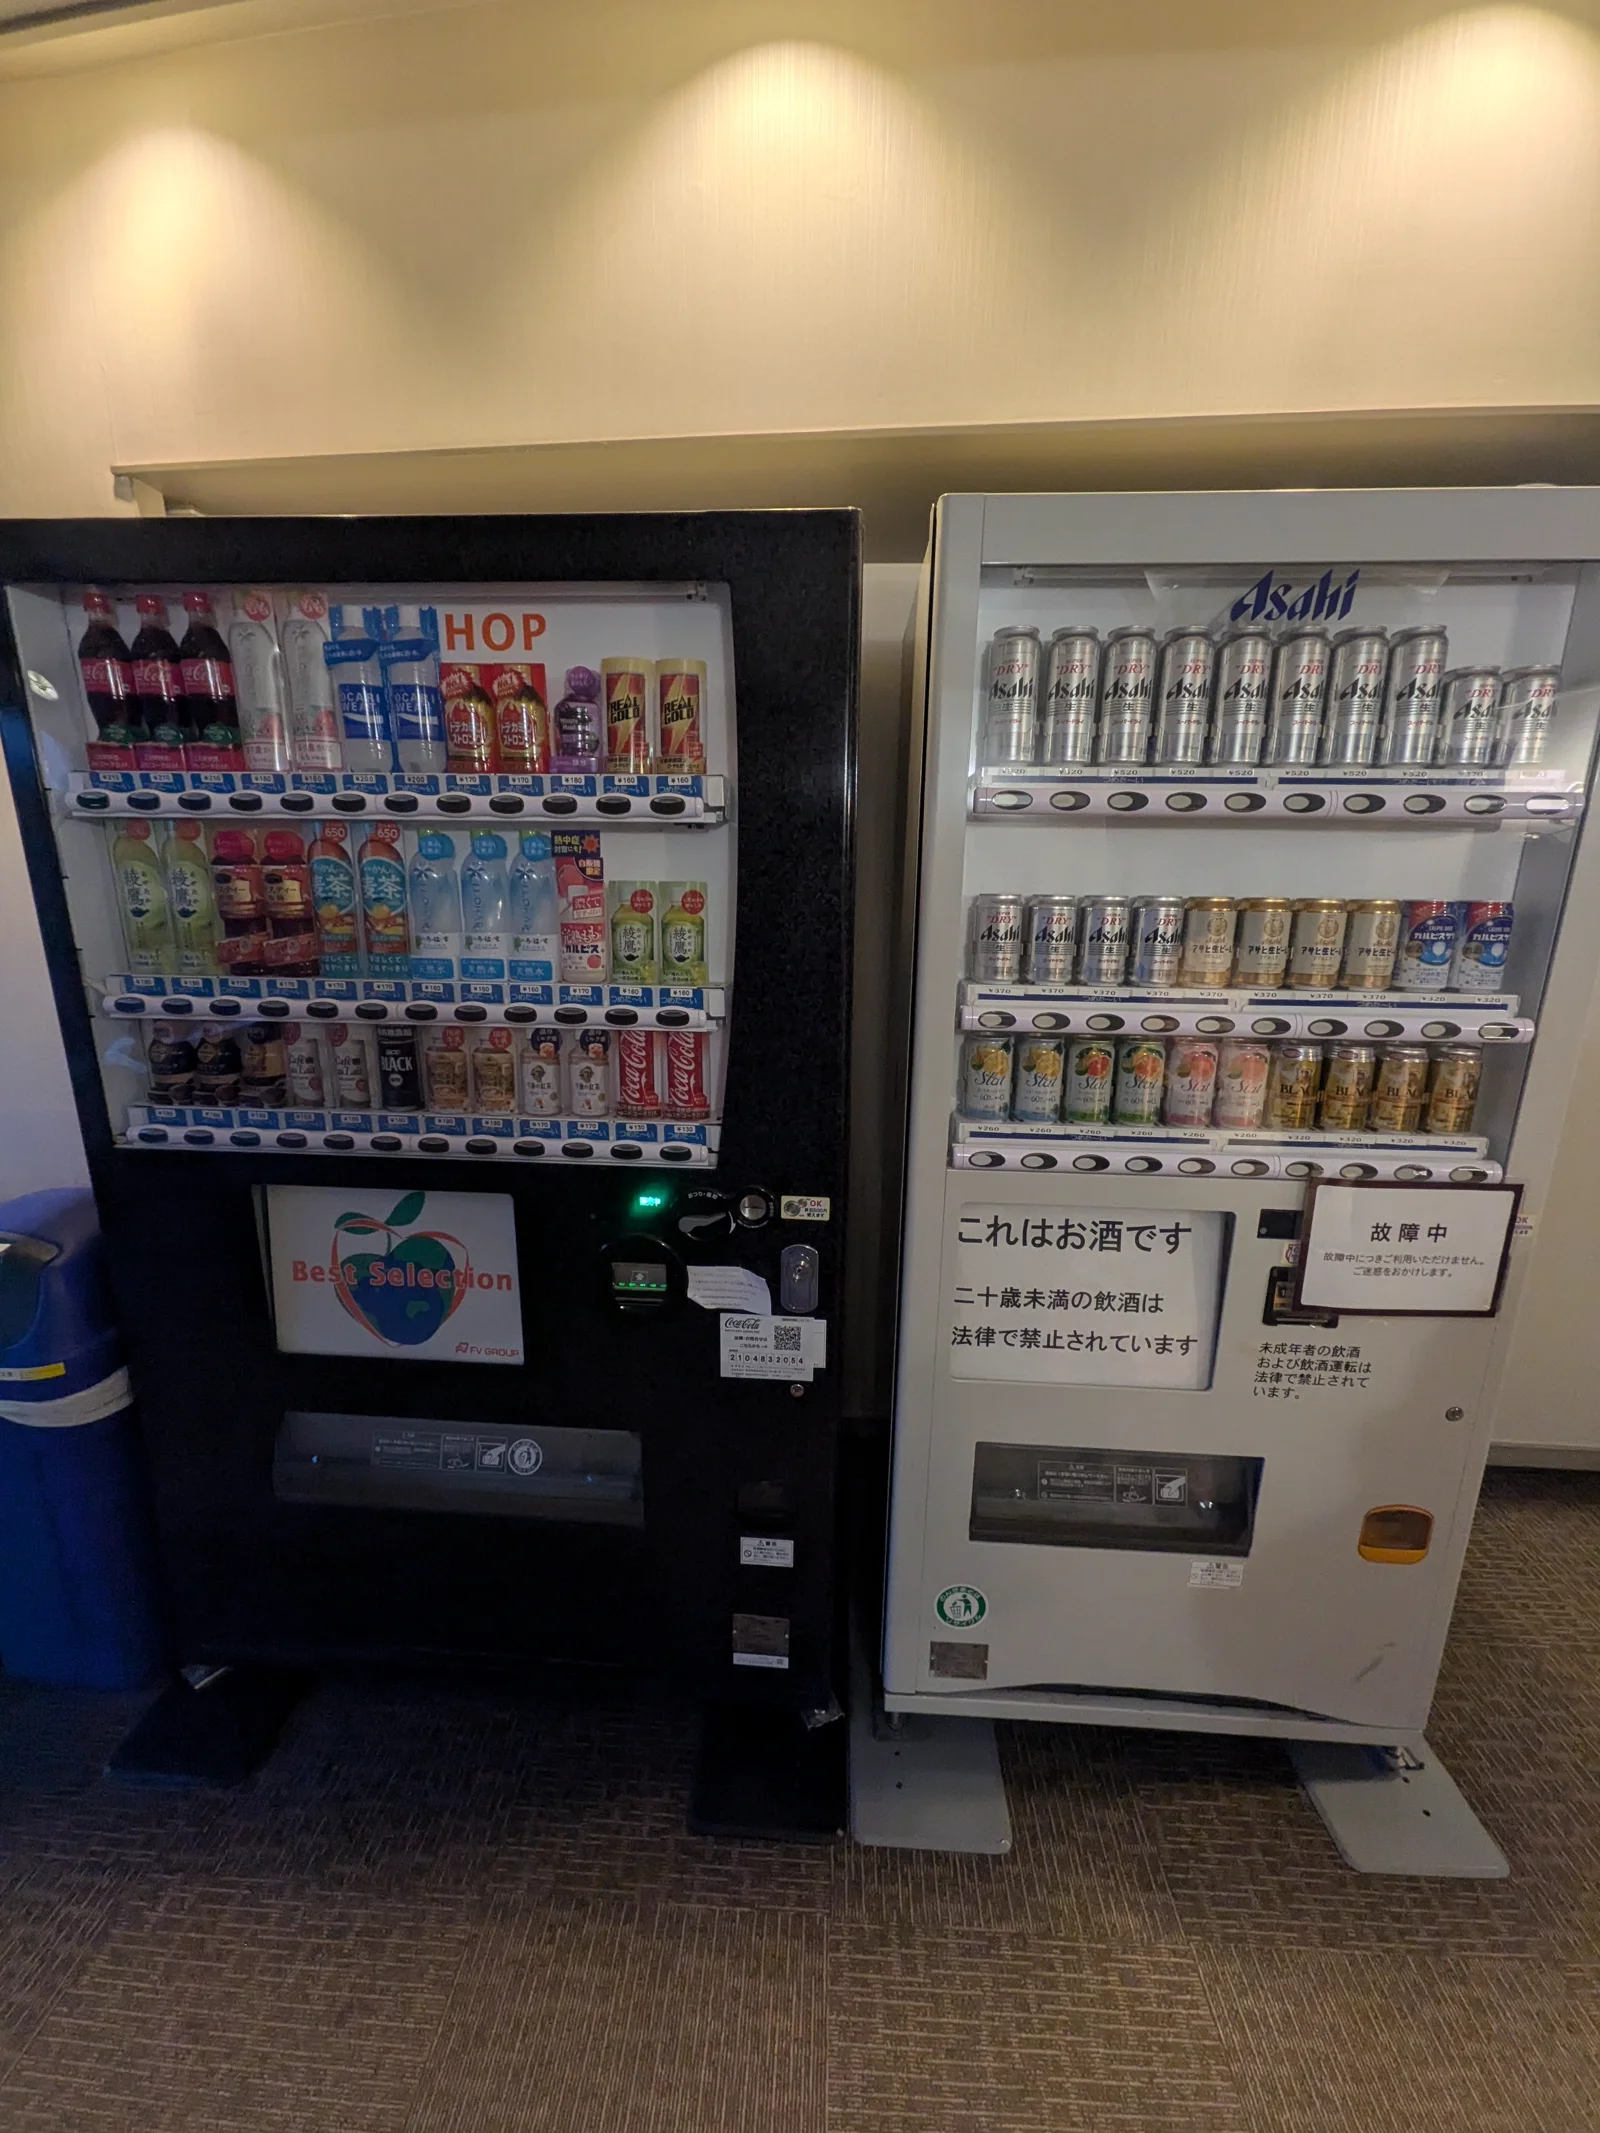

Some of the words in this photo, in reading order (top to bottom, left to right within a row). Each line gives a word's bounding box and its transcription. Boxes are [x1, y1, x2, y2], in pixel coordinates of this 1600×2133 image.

[1229, 568, 1361, 622] Asahi
[444, 612, 546, 652] HOP
[989, 676, 1034, 701] Asahi
[1048, 678, 1094, 701] Asahi
[608, 693, 640, 712] REAL
[664, 693, 694, 713] REAL
[610, 707, 640, 724] GOLD
[664, 707, 694, 725] GOLD
[407, 775, 425, 784] ¥200
[459, 776, 477, 784] ¥170
[512, 777, 530, 785] ¥170
[564, 777, 583, 785] ¥180
[671, 777, 689, 785] ¥160
[324, 829, 345, 837] 650
[377, 829, 398, 838] 650
[554, 835, 580, 845] 熱中症
[622, 926, 637, 954] 綾鷹
[672, 926, 687, 955] 綾鷹
[980, 925, 1020, 941] Asahi
[1035, 925, 1074, 942] Asahi
[564, 944, 600, 954] カルピス
[424, 984, 442, 992] ¥160
[381, 1055, 413, 1071] BLACK
[958, 1214, 1193, 1255] これはお酒です
[1370, 1222, 1448, 1243] 故障中
[1323, 1251, 1485, 1266] 故障中につきご利用いただけません。
[291, 1260, 357, 1285] Best
[369, 1262, 513, 1291] Selection
[1353, 1266, 1453, 1278] ご迷惑をおかけします。
[953, 1286, 1164, 1314] 二十歳未満の飲酒は
[951, 1325, 1199, 1357] 法律で禁止されています
[484, 1347, 520, 1358] GROUP
[1259, 1342, 1361, 1359] 未成年者の飲酒
[1256, 1358, 1372, 1374] および飲酒運転は
[1254, 1372, 1370, 1388] 法律で禁止されて
[1253, 1386, 1301, 1400] います。
